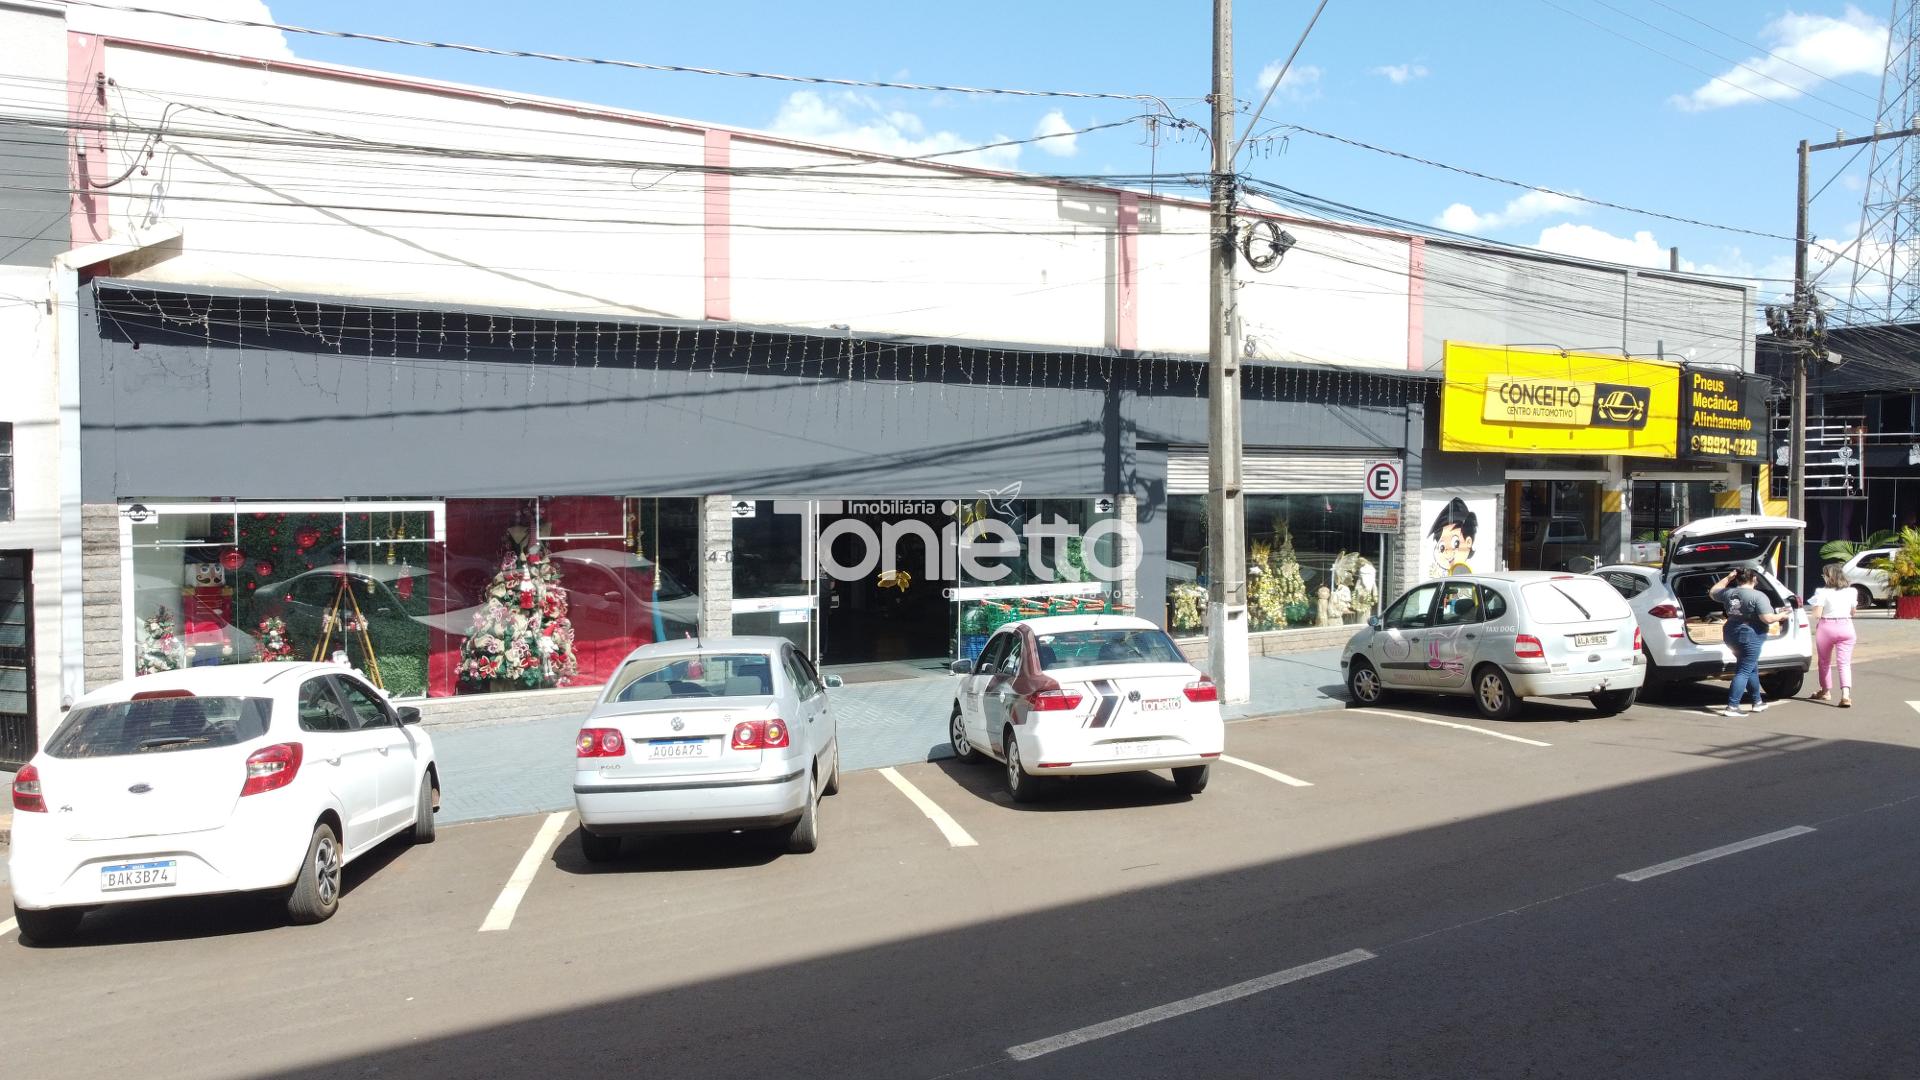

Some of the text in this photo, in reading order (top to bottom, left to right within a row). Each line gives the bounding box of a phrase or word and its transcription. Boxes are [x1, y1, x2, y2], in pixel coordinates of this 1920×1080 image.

[1693, 373, 1724, 392] Pneus
[1500, 382, 1581, 408] CONCEITO
[1692, 392, 1739, 412] Mecânica
[1506, 406, 1573, 418] CENTRO AUTOMOTIVO
[1692, 410, 1752, 431] Alinhamento
[1375, 470, 1390, 491] E
[1500, 625, 1515, 633] DOG
[108, 869, 168, 887] BAK3B74
